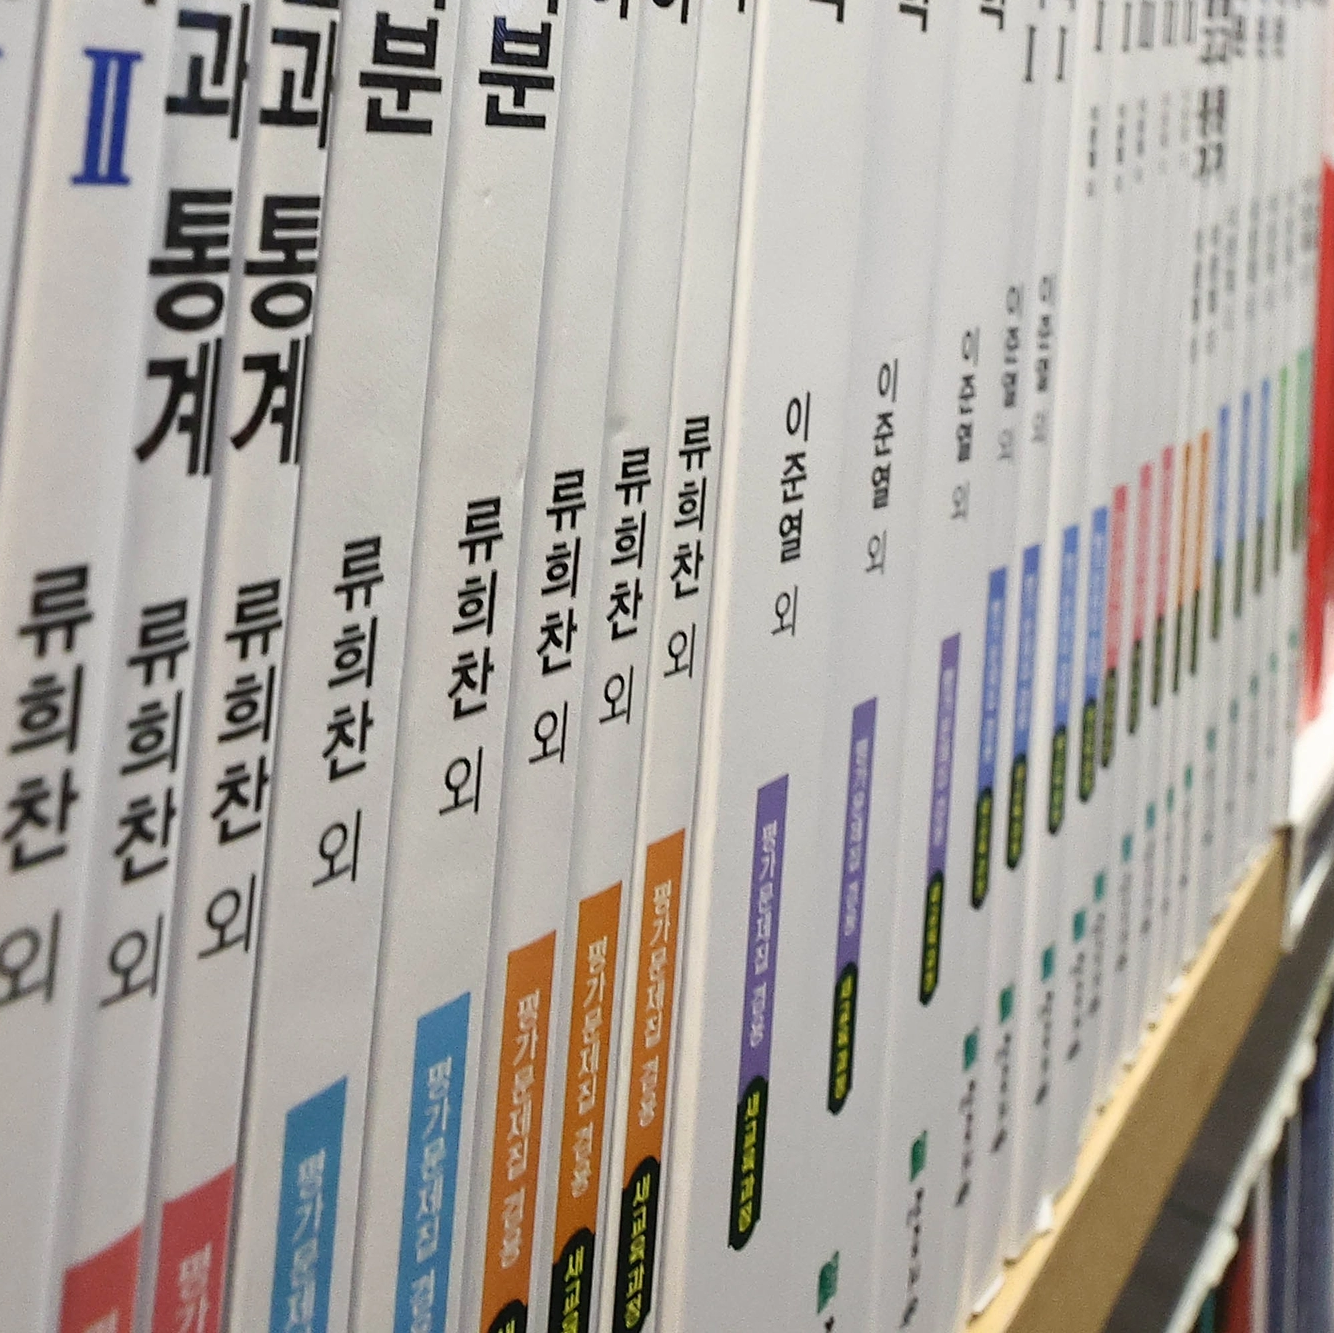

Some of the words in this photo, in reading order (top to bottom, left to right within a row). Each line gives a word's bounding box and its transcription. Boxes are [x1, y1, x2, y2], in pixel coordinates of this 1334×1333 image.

[134, 188, 234, 477] 통계
[231, 194, 322, 465] 통계
[670, 415, 711, 600] 류희찬
[778, 390, 812, 563] 이준열
[871, 357, 898, 510] 이준열
[447, 496, 503, 720] 류희찬
[536, 469, 586, 676] 류희찬
[606, 447, 651, 642] 류희찬
[770, 584, 798, 636] 외
[865, 529, 886, 575] 외
[0, 563, 94, 872] 류희찬
[210, 579, 283, 847] 류희찬
[322, 536, 385, 783] 류희찬
[528, 700, 568, 765] 외
[599, 664, 634, 725] 외
[663, 622, 697, 679] 외
[113, 598, 191, 884] 류희찬
[439, 745, 484, 816] 외
[196, 873, 258, 962] 외
[312, 808, 362, 888] 외
[98, 913, 165, 1010] 외
